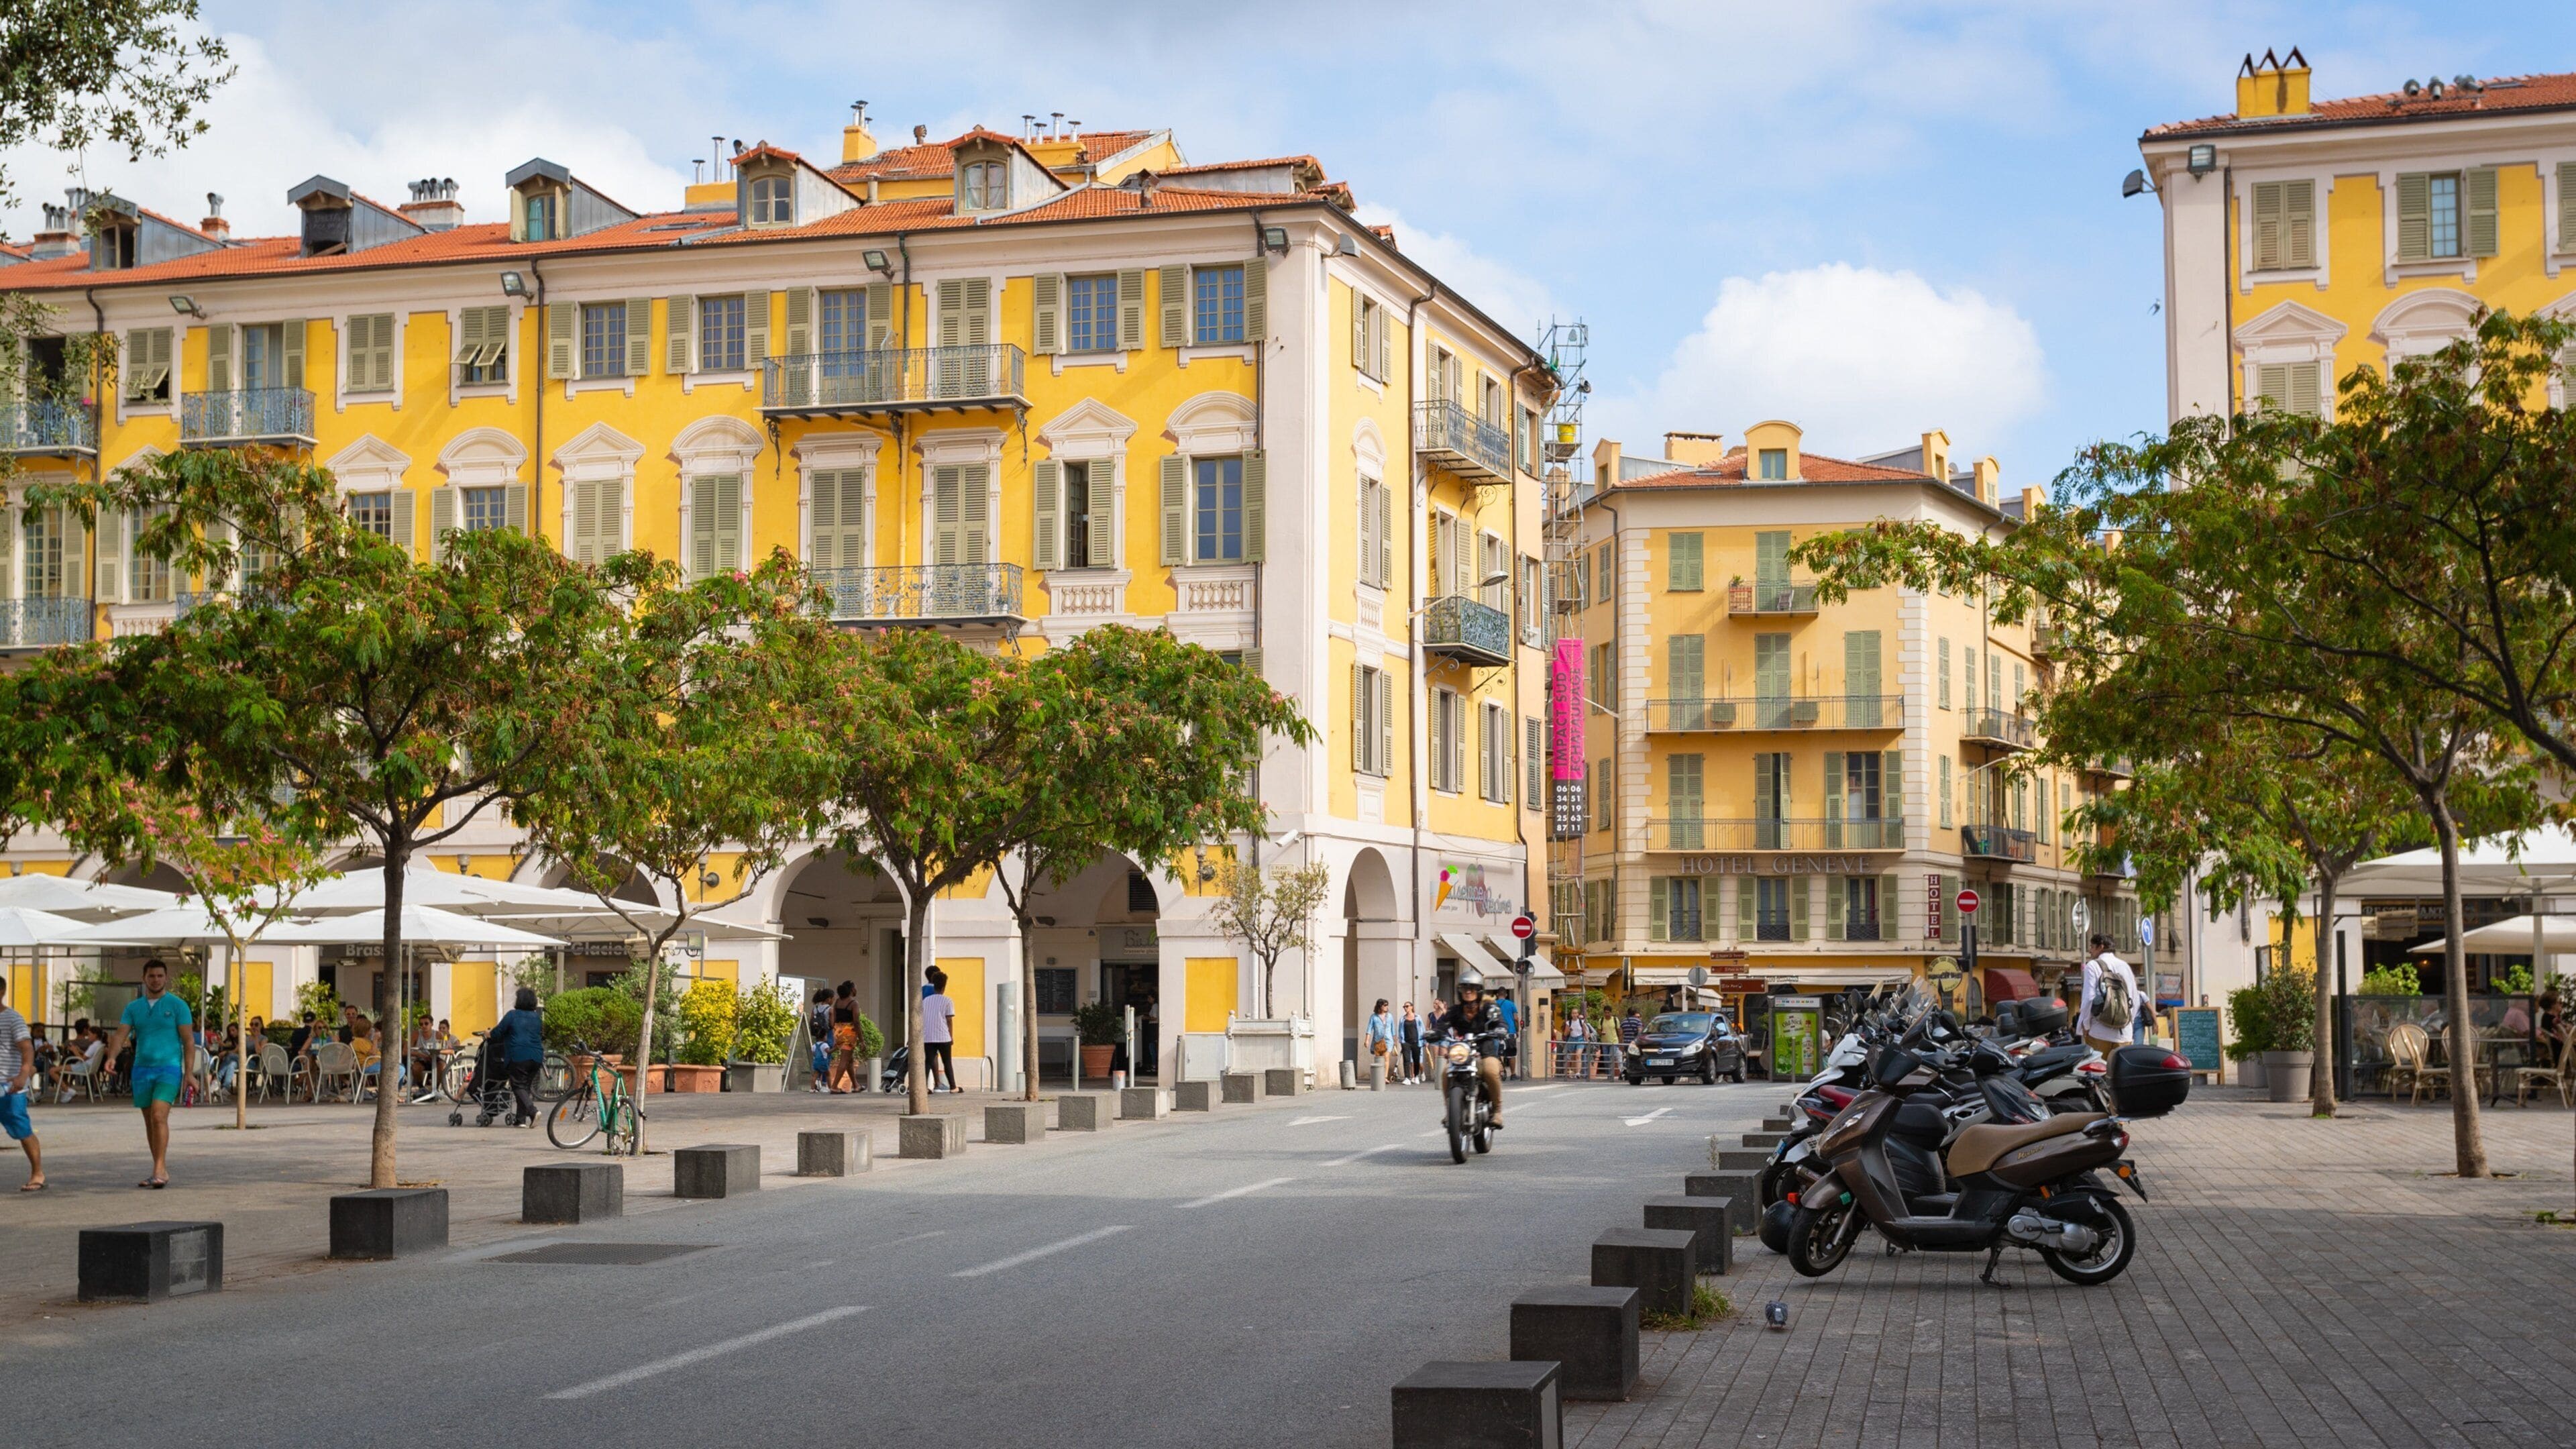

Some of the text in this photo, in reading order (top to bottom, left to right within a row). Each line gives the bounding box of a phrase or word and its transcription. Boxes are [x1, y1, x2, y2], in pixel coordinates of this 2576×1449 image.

[1556, 672, 1567, 766] IMPACT SUD
[1680, 856, 1871, 873] HOTEL GENEVE
[1929, 875, 1938, 938] HOTEL
